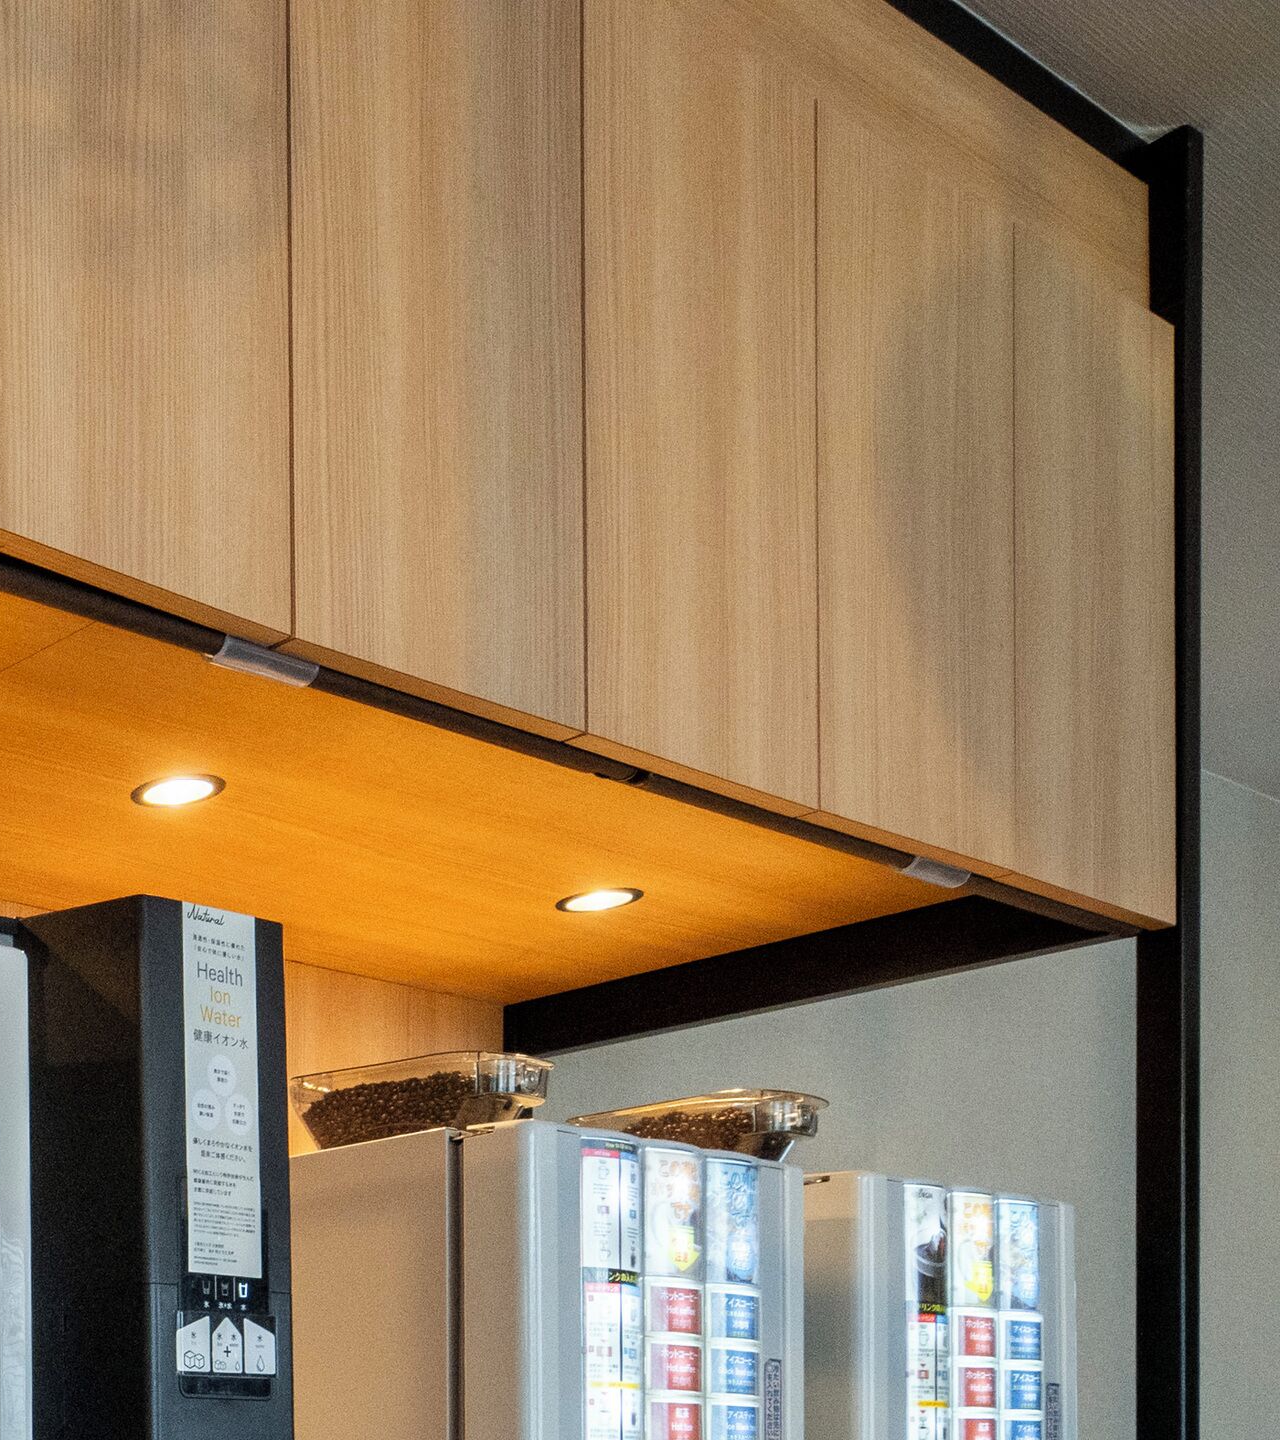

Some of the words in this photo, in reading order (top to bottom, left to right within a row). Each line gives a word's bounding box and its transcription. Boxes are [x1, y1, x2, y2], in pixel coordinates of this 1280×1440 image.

[197, 961, 243, 987] Health
[210, 986, 231, 1005] Ion
[200, 1004, 242, 1029] Water
[193, 1029, 248, 1049] 健康イオン水
